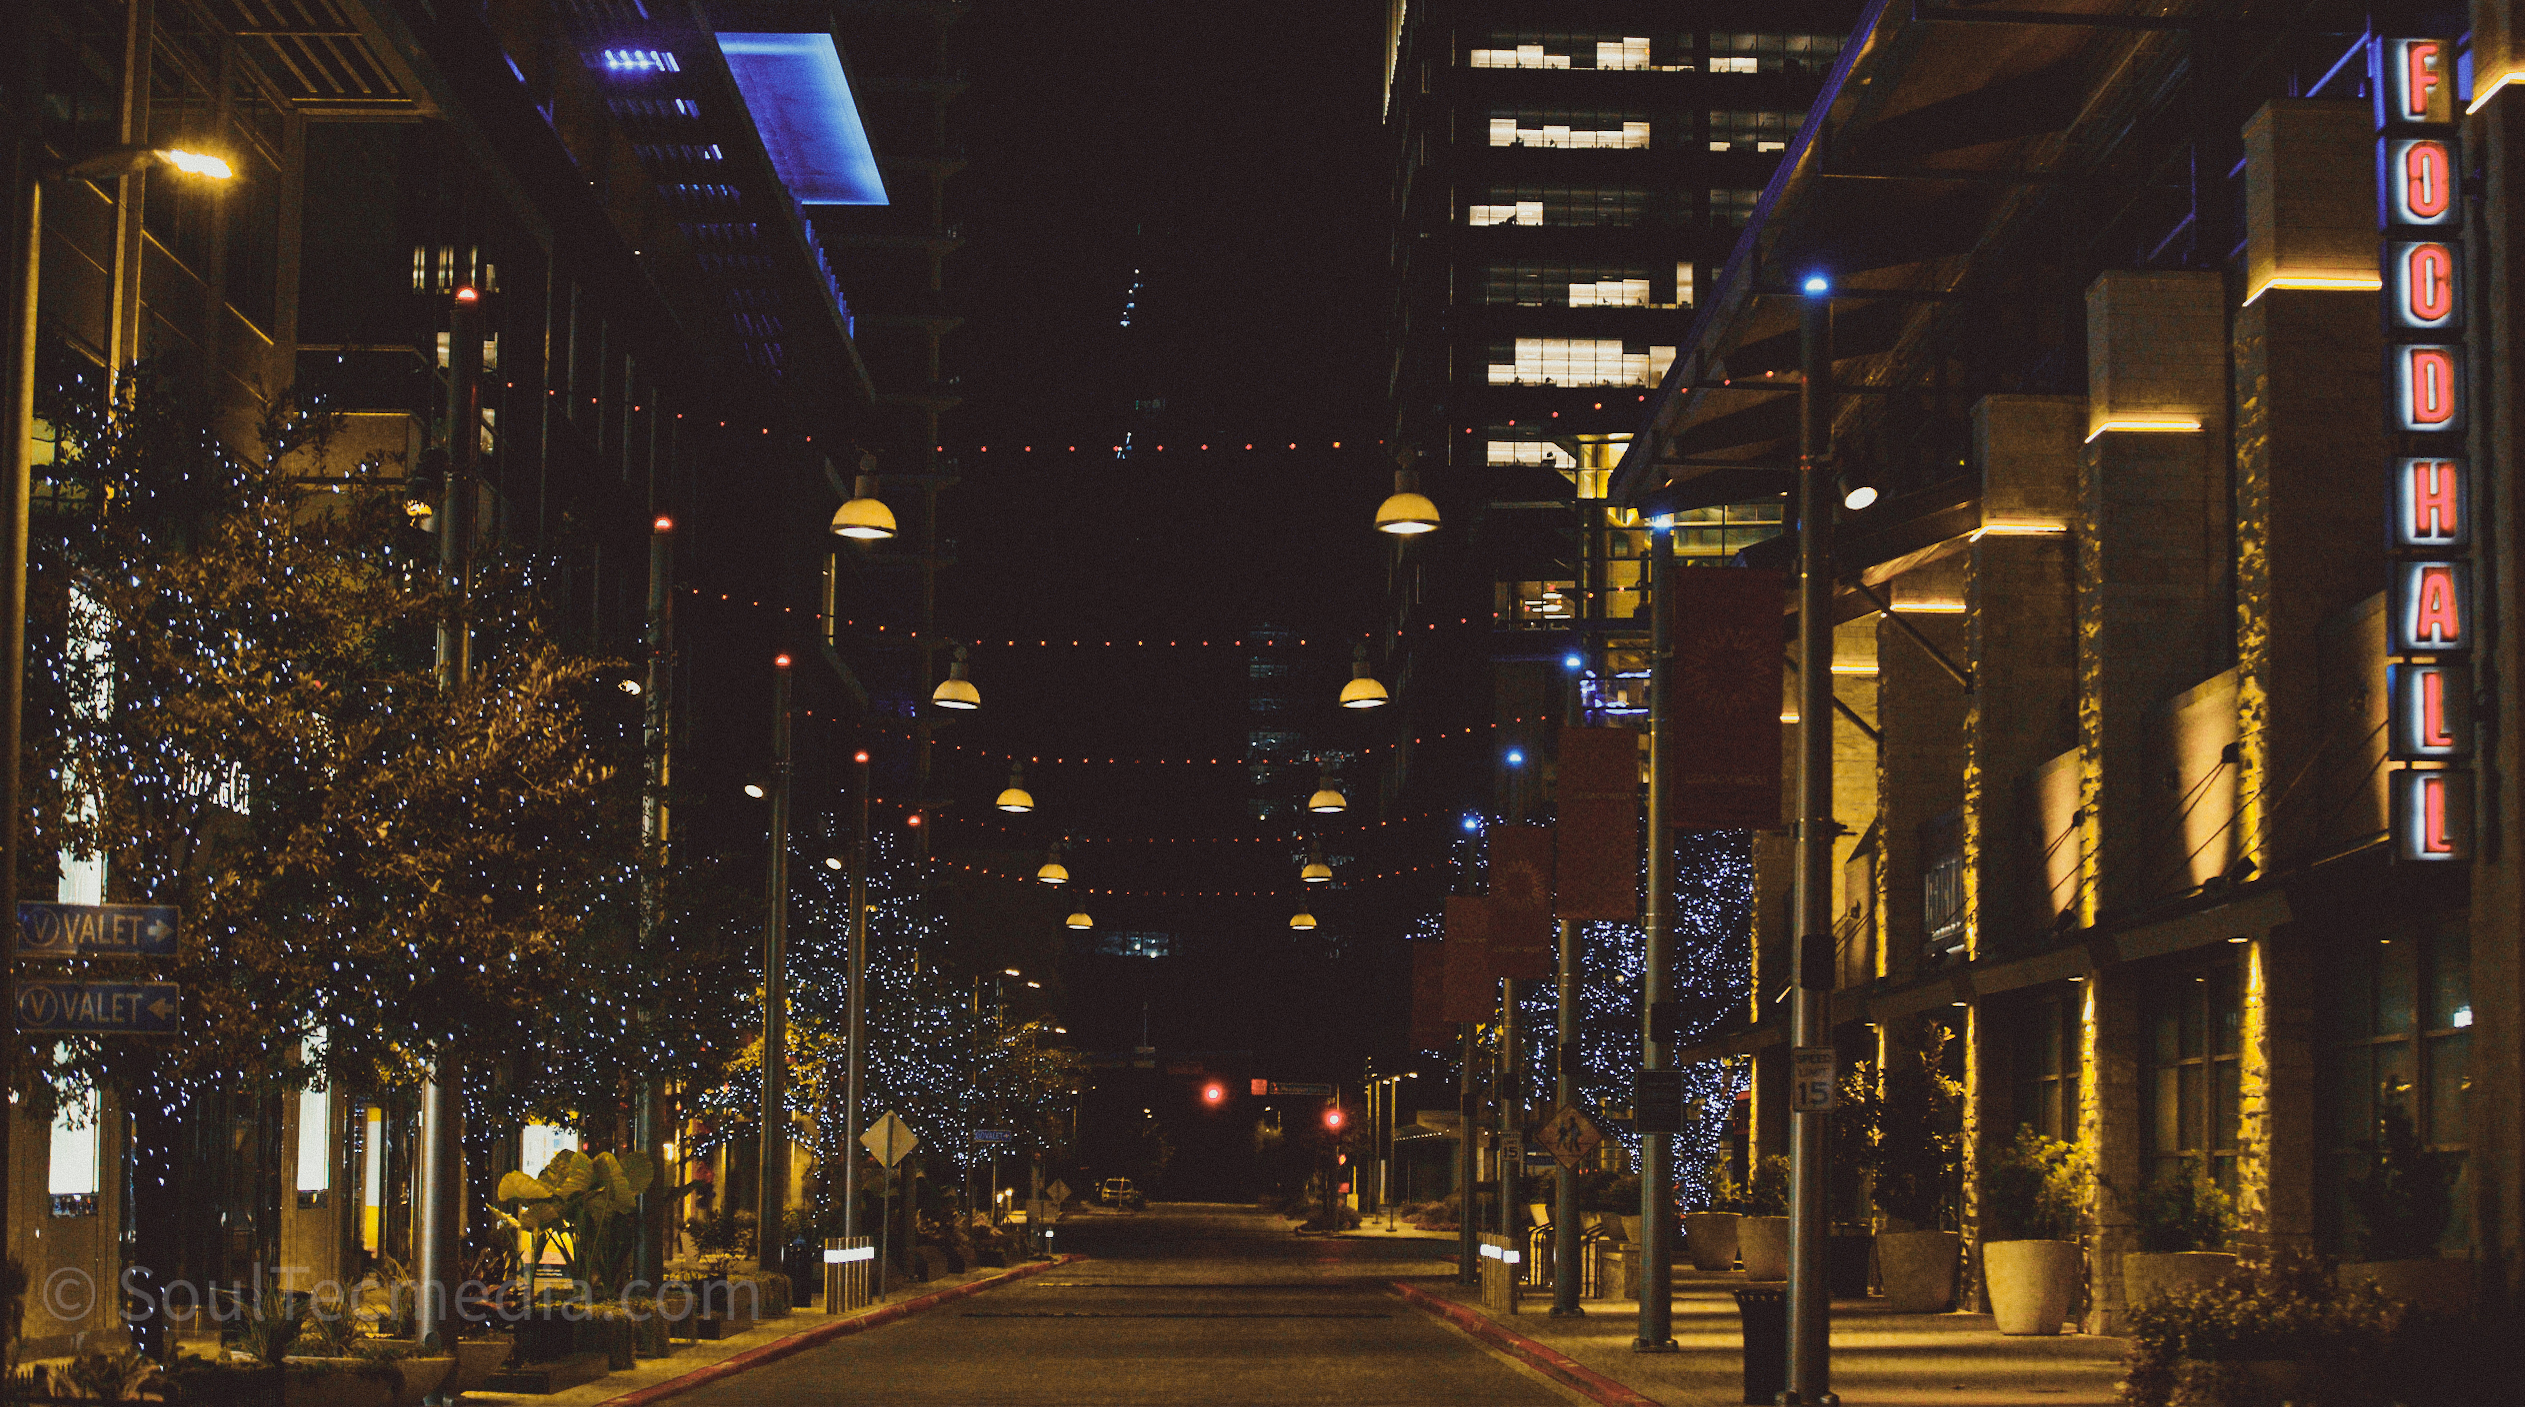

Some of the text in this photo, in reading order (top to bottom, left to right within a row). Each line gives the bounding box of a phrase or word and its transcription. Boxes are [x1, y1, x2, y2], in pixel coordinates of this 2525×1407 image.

[2413, 461, 2461, 853] HALL
[63, 913, 144, 945] VALET
[61, 991, 144, 1023] VALET
[1798, 1082, 1829, 1105] 15
[1503, 1146, 1518, 1158] 15
